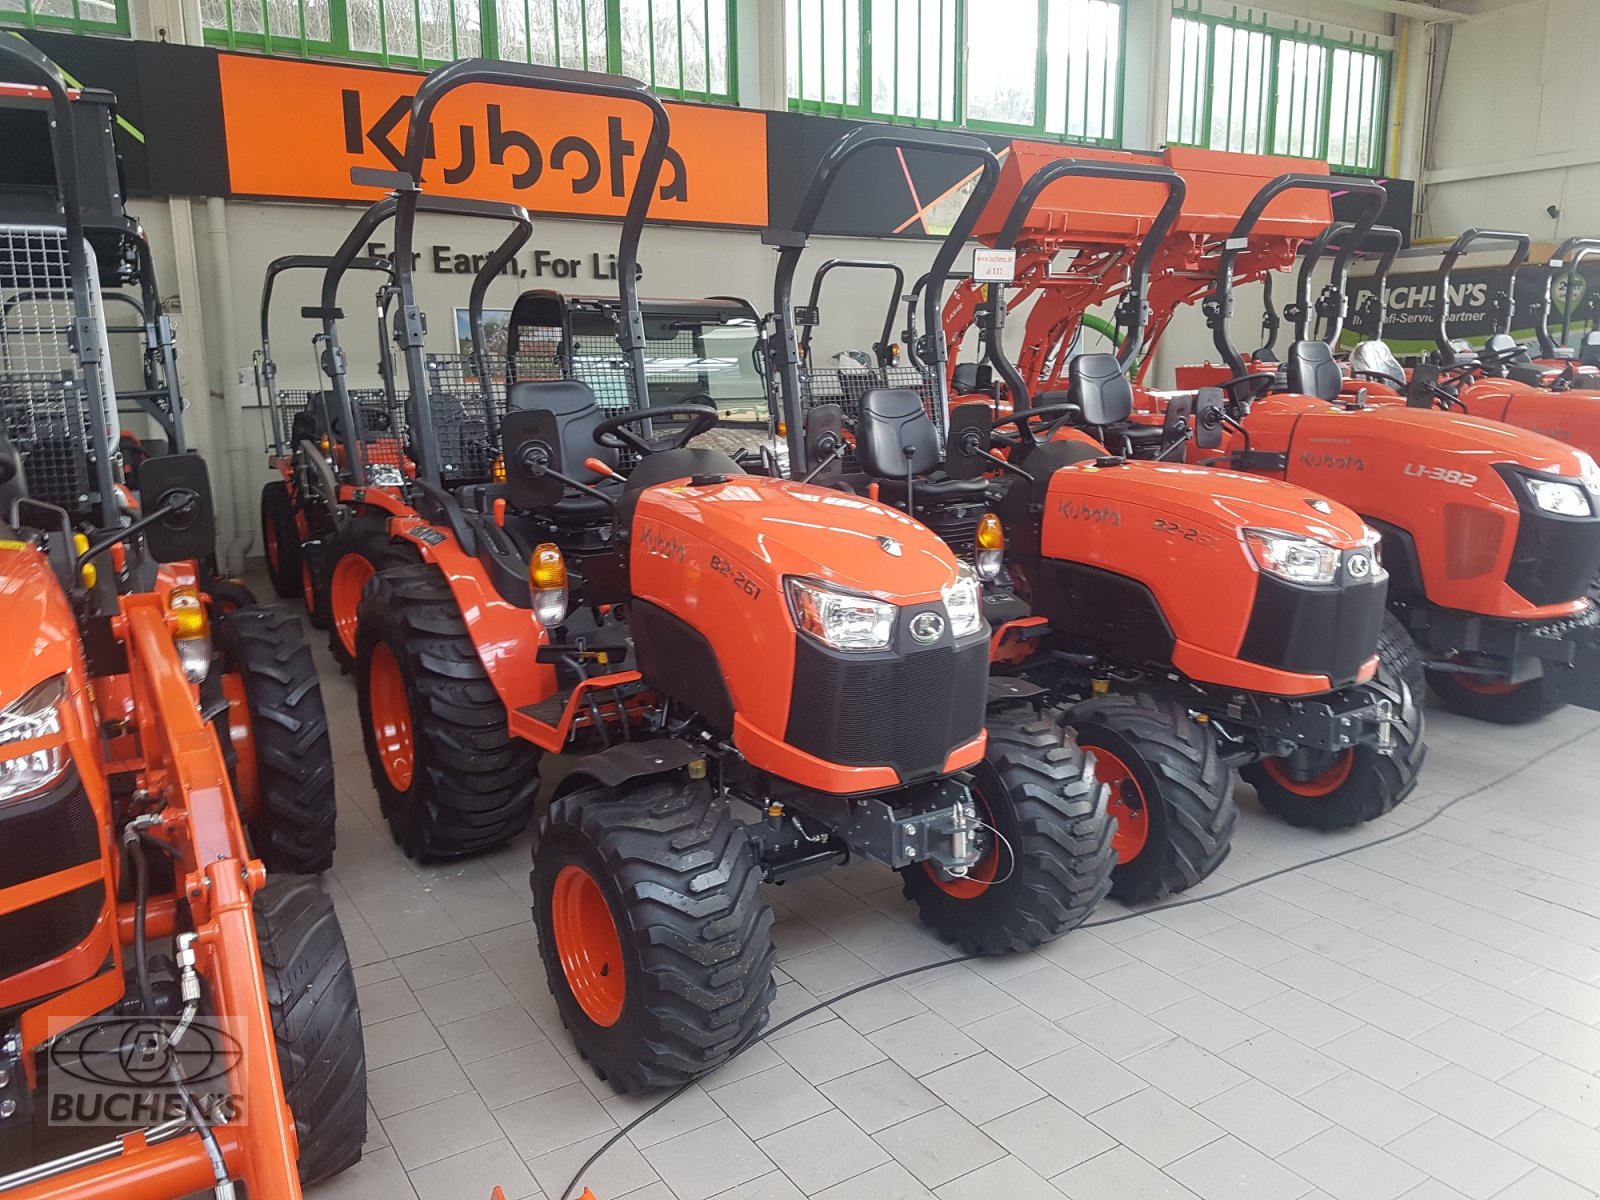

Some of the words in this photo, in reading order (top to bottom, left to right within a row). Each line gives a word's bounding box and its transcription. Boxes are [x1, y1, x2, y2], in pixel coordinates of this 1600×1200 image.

[341, 88, 688, 203] Kubota
[432, 245, 527, 279] Earh,
[534, 249, 582, 278] For
[1354, 282, 1487, 311] BCHN'S
[1058, 499, 1121, 526] Kubota
[710, 555, 762, 600] B2-261
